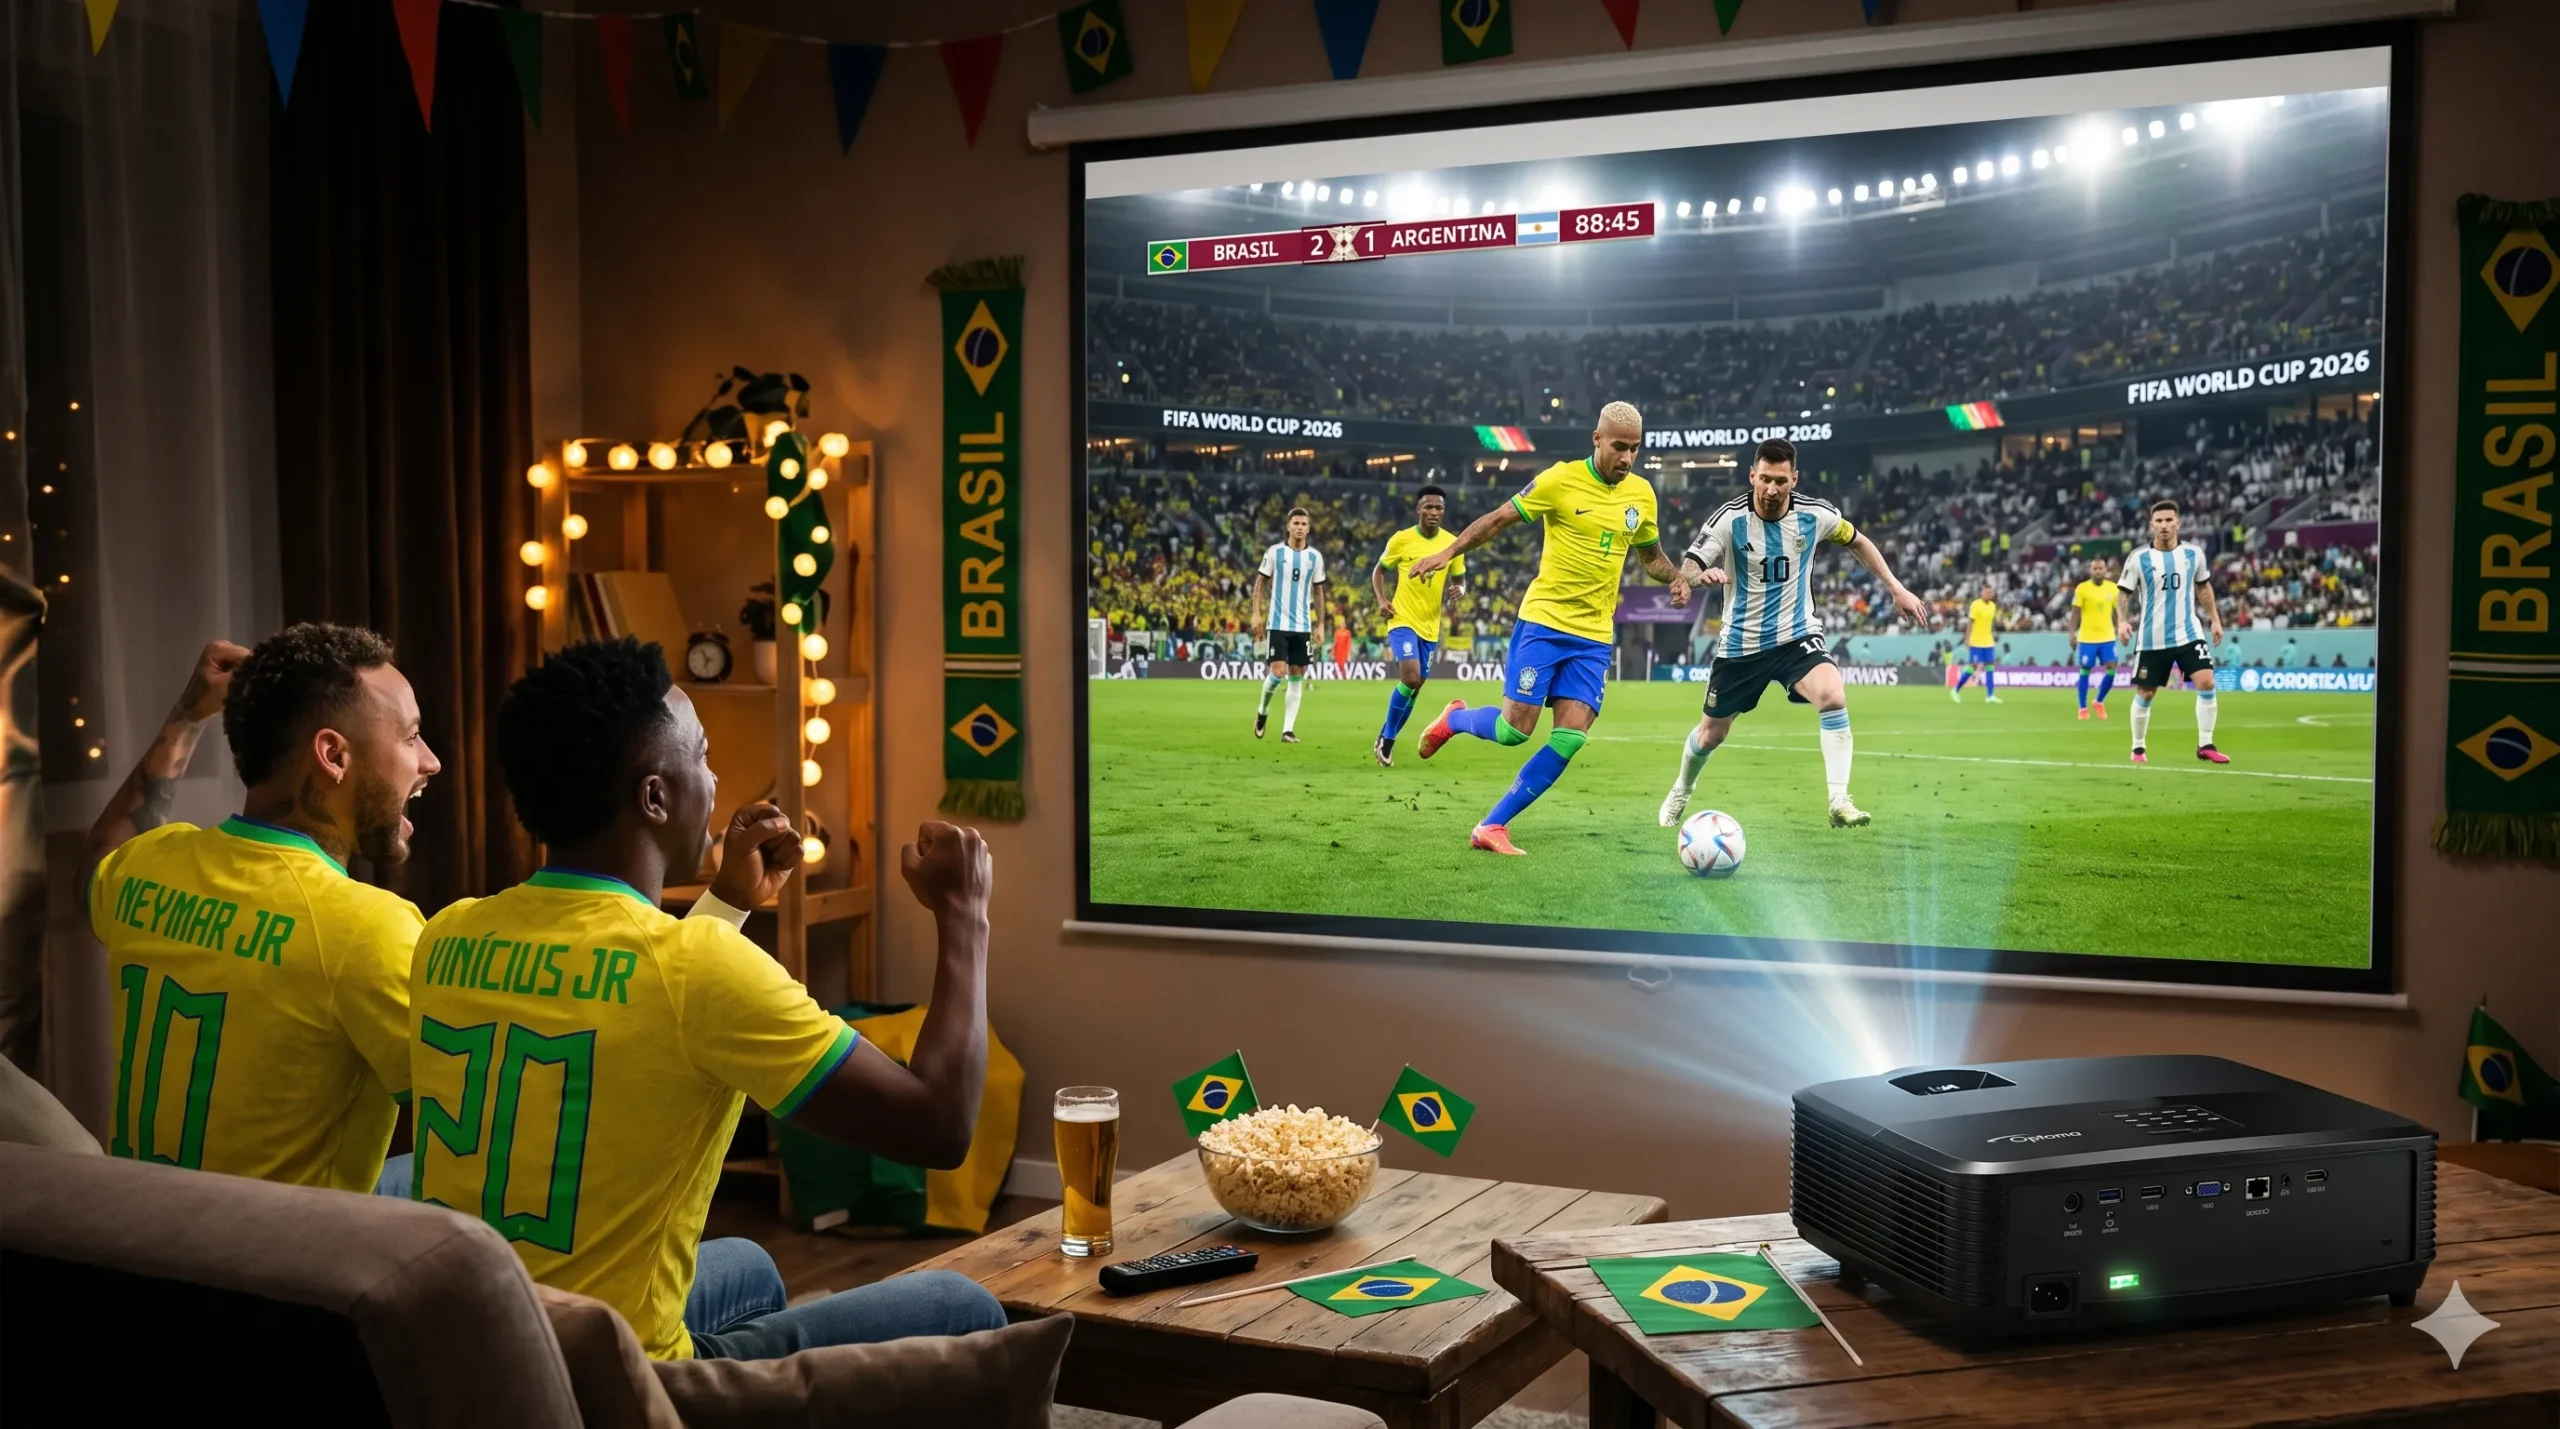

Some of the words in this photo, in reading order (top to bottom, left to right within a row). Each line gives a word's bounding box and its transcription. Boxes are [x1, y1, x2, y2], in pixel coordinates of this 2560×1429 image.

[1213, 241, 1279, 262] BRASIL
[1310, 234, 1324, 256] 2
[1364, 230, 1374, 252] 1
[1391, 222, 1507, 248] ARGENTINA
[1575, 213, 1641, 235] 88:45
[2128, 379, 2172, 404] FIFA
[2174, 367, 2255, 398] WORLD
[2259, 360, 2305, 386] CUP
[2308, 349, 2370, 379] 2026
[1163, 409, 1200, 429] FIFA
[1201, 412, 1264, 432] WORLD
[1266, 417, 1300, 435] CUP
[1302, 419, 1343, 438] 2026
[1645, 430, 1683, 448] FIFA
[1684, 428, 1749, 447] WORLD
[1751, 426, 1787, 444] CUP
[1788, 423, 1832, 442] 2026
[958, 412, 1005, 638] BRASIL
[2478, 352, 2558, 634] BRASIL
[1759, 555, 1790, 583] 10
[1303, 661, 1386, 681] AIRWAYS
[115, 876, 238, 952] NEYMAR
[234, 909, 295, 967] JR
[425, 931, 570, 997] VINÍCIUS
[572, 947, 637, 1005] JR
[111, 963, 228, 1170] 10
[412, 1014, 597, 1255] 20
